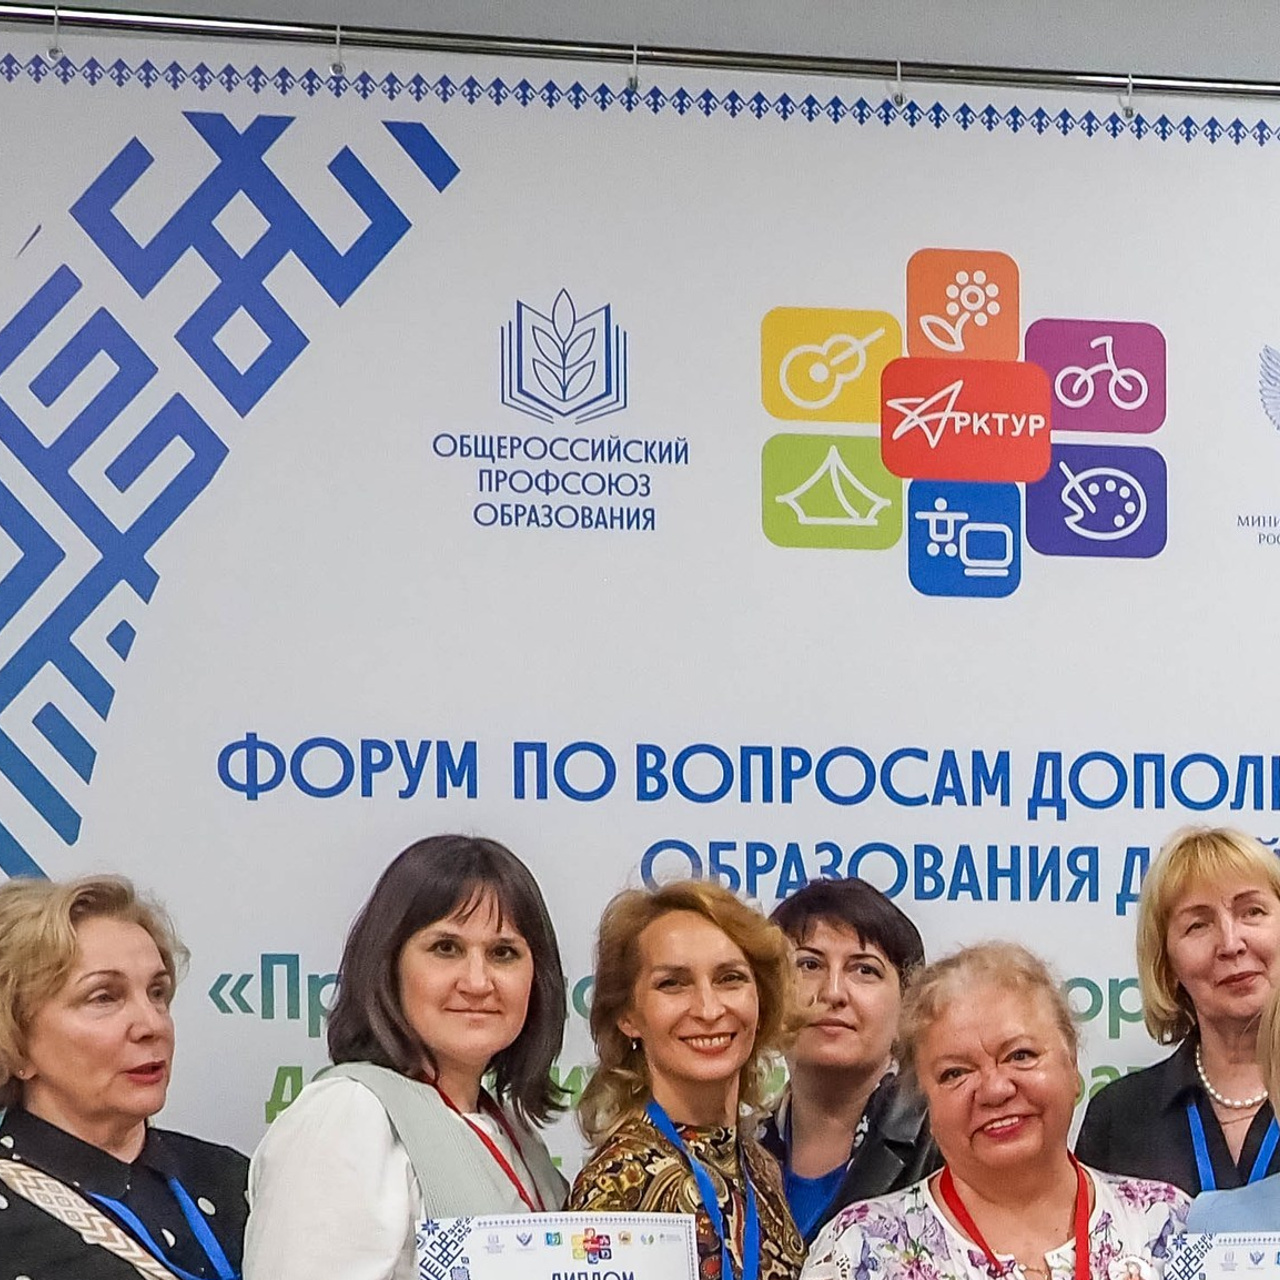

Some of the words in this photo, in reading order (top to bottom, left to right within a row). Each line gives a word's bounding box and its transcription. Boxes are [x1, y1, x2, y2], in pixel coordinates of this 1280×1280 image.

[432, 433, 690, 465] ОБЩЕРОССИЙСКИЙ
[478, 468, 651, 497] ПРОФСОЮЗ
[473, 502, 656, 531] ОБРАЗОВАНИЯ
[217, 731, 478, 800] ФОРУМ
[513, 741, 617, 802] ПО
[635, 742, 1011, 808] ВОПРОСАМ
[640, 839, 1099, 903] ОБРАЗОВАНИЯ
